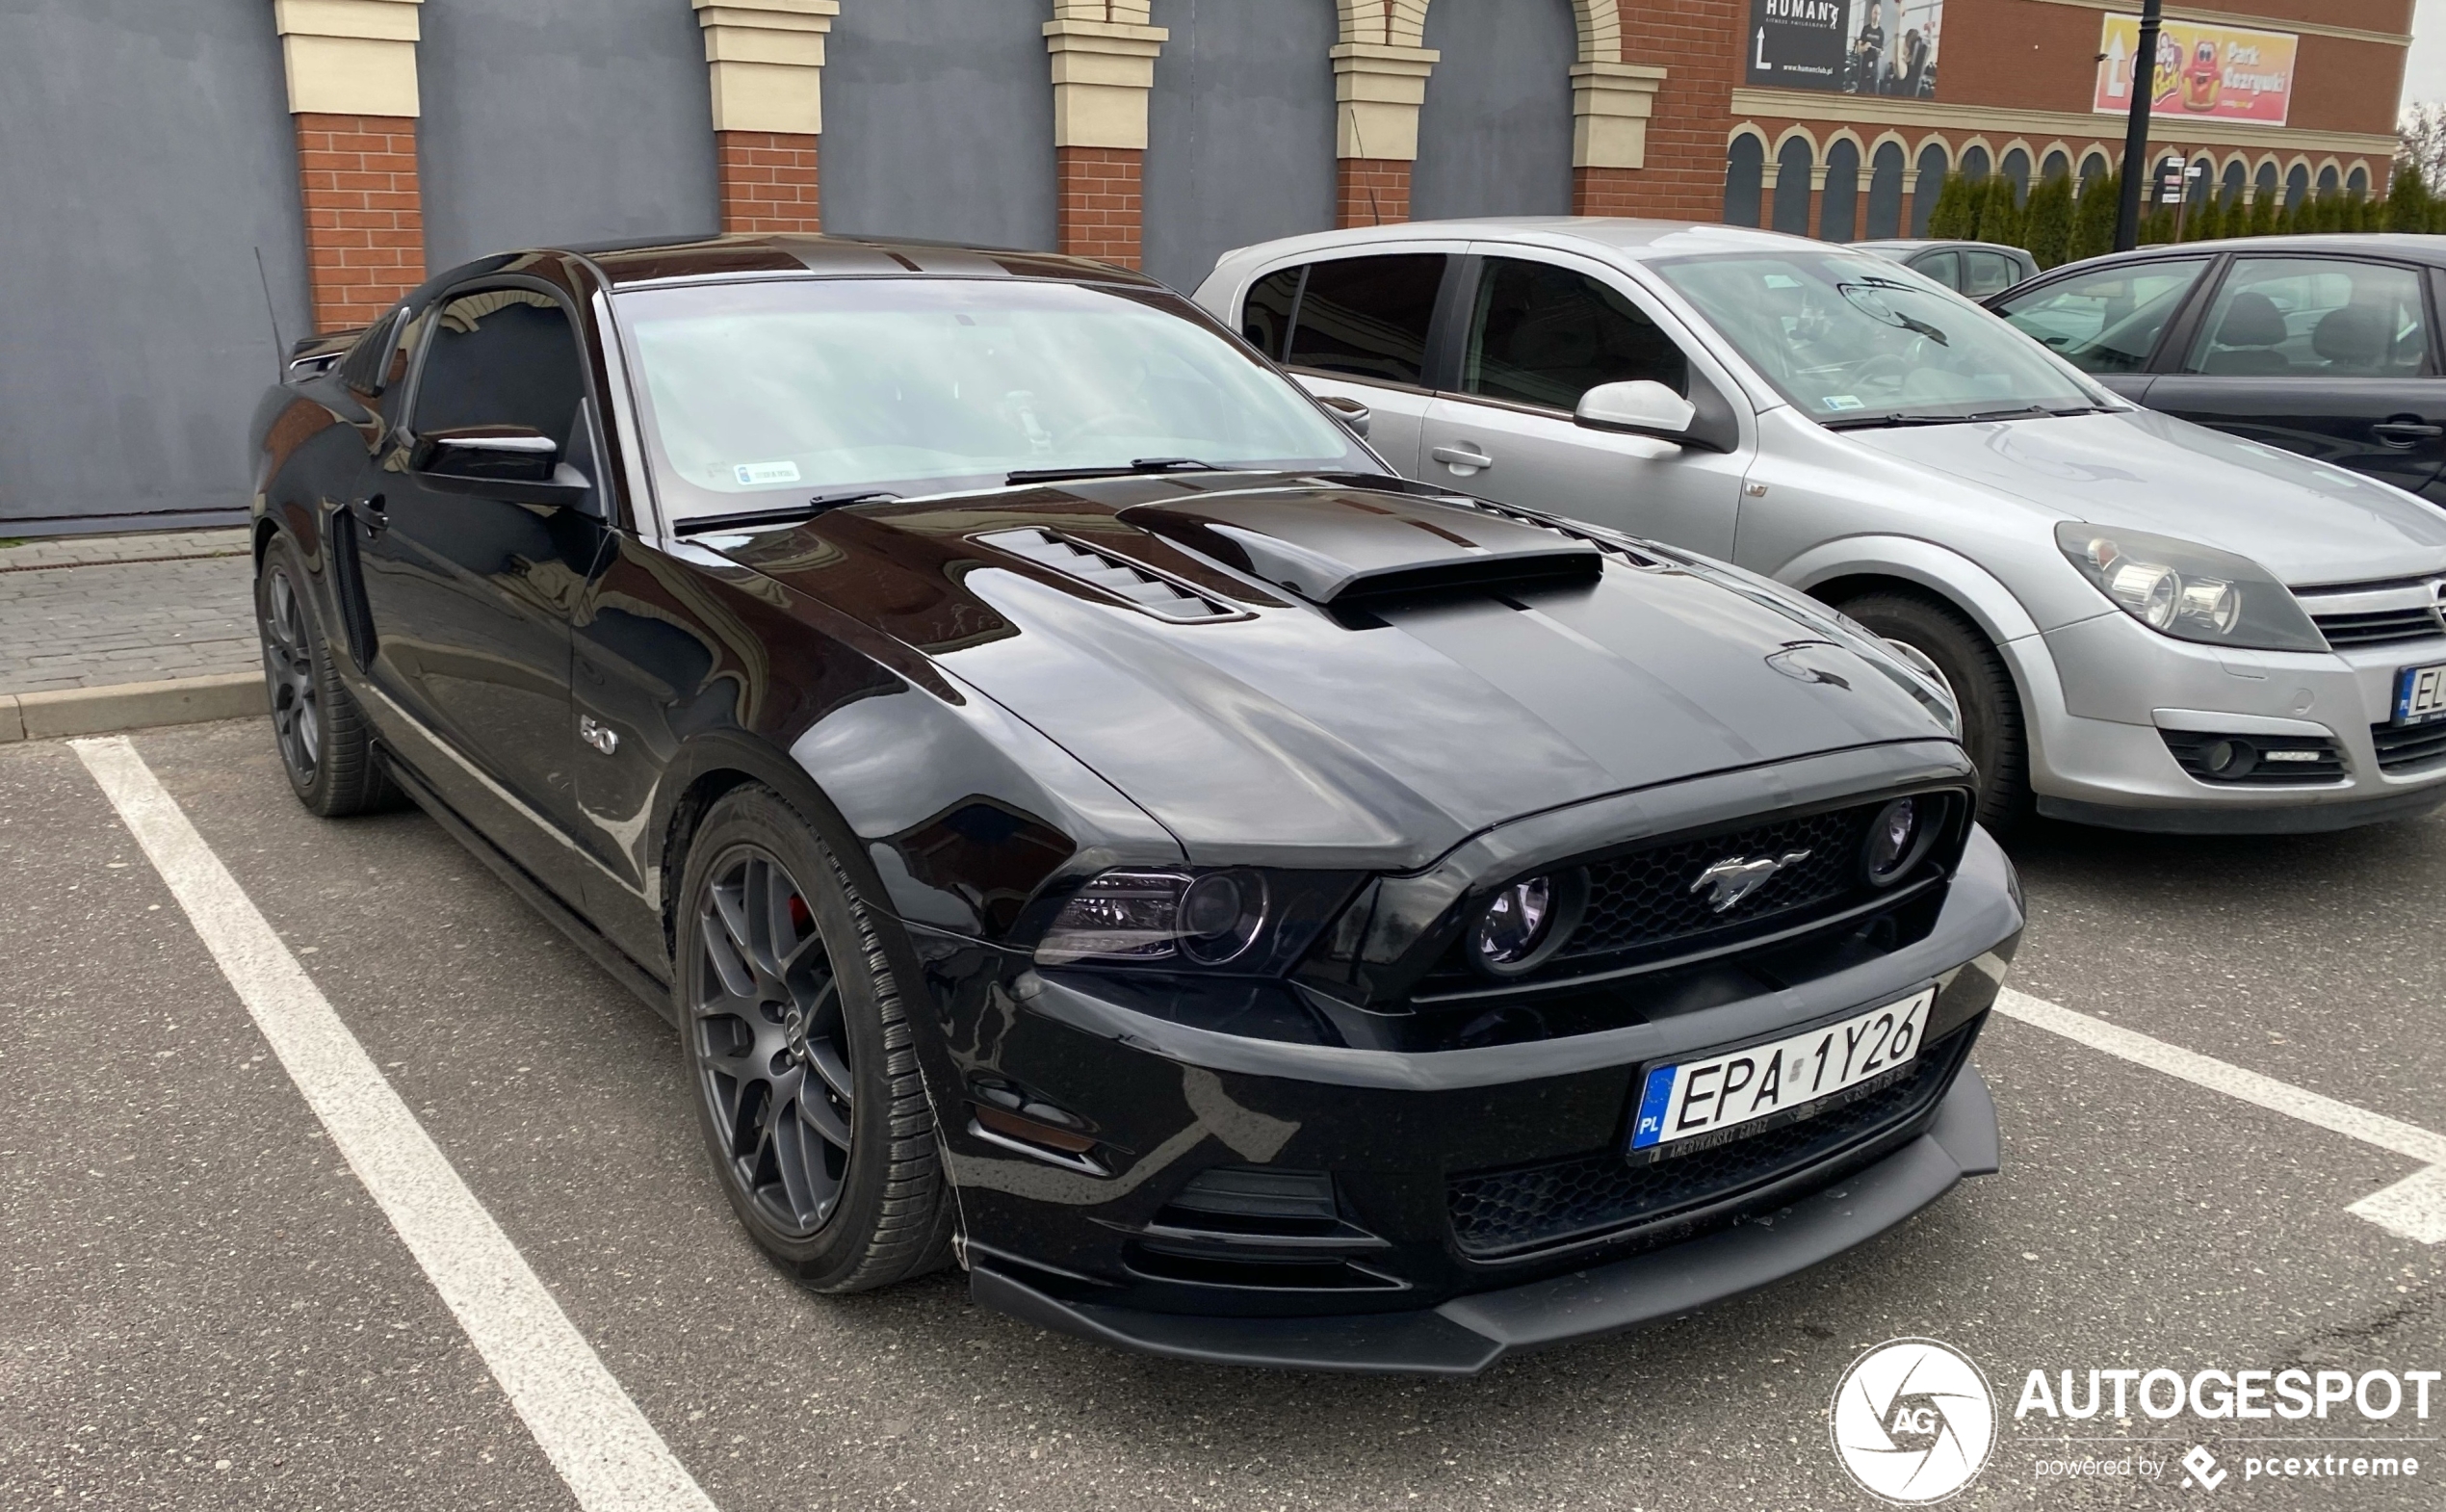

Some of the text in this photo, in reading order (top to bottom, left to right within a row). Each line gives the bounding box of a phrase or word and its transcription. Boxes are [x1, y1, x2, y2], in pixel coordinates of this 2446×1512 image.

[1766, 0, 1828, 20] HUMAN
[2227, 41, 2259, 66] Park
[2223, 66, 2286, 94] Rozrywki
[1676, 1048, 1783, 1133] EPA
[1811, 999, 1924, 1093] 1Y26
[1639, 1115, 1659, 1135] PL
